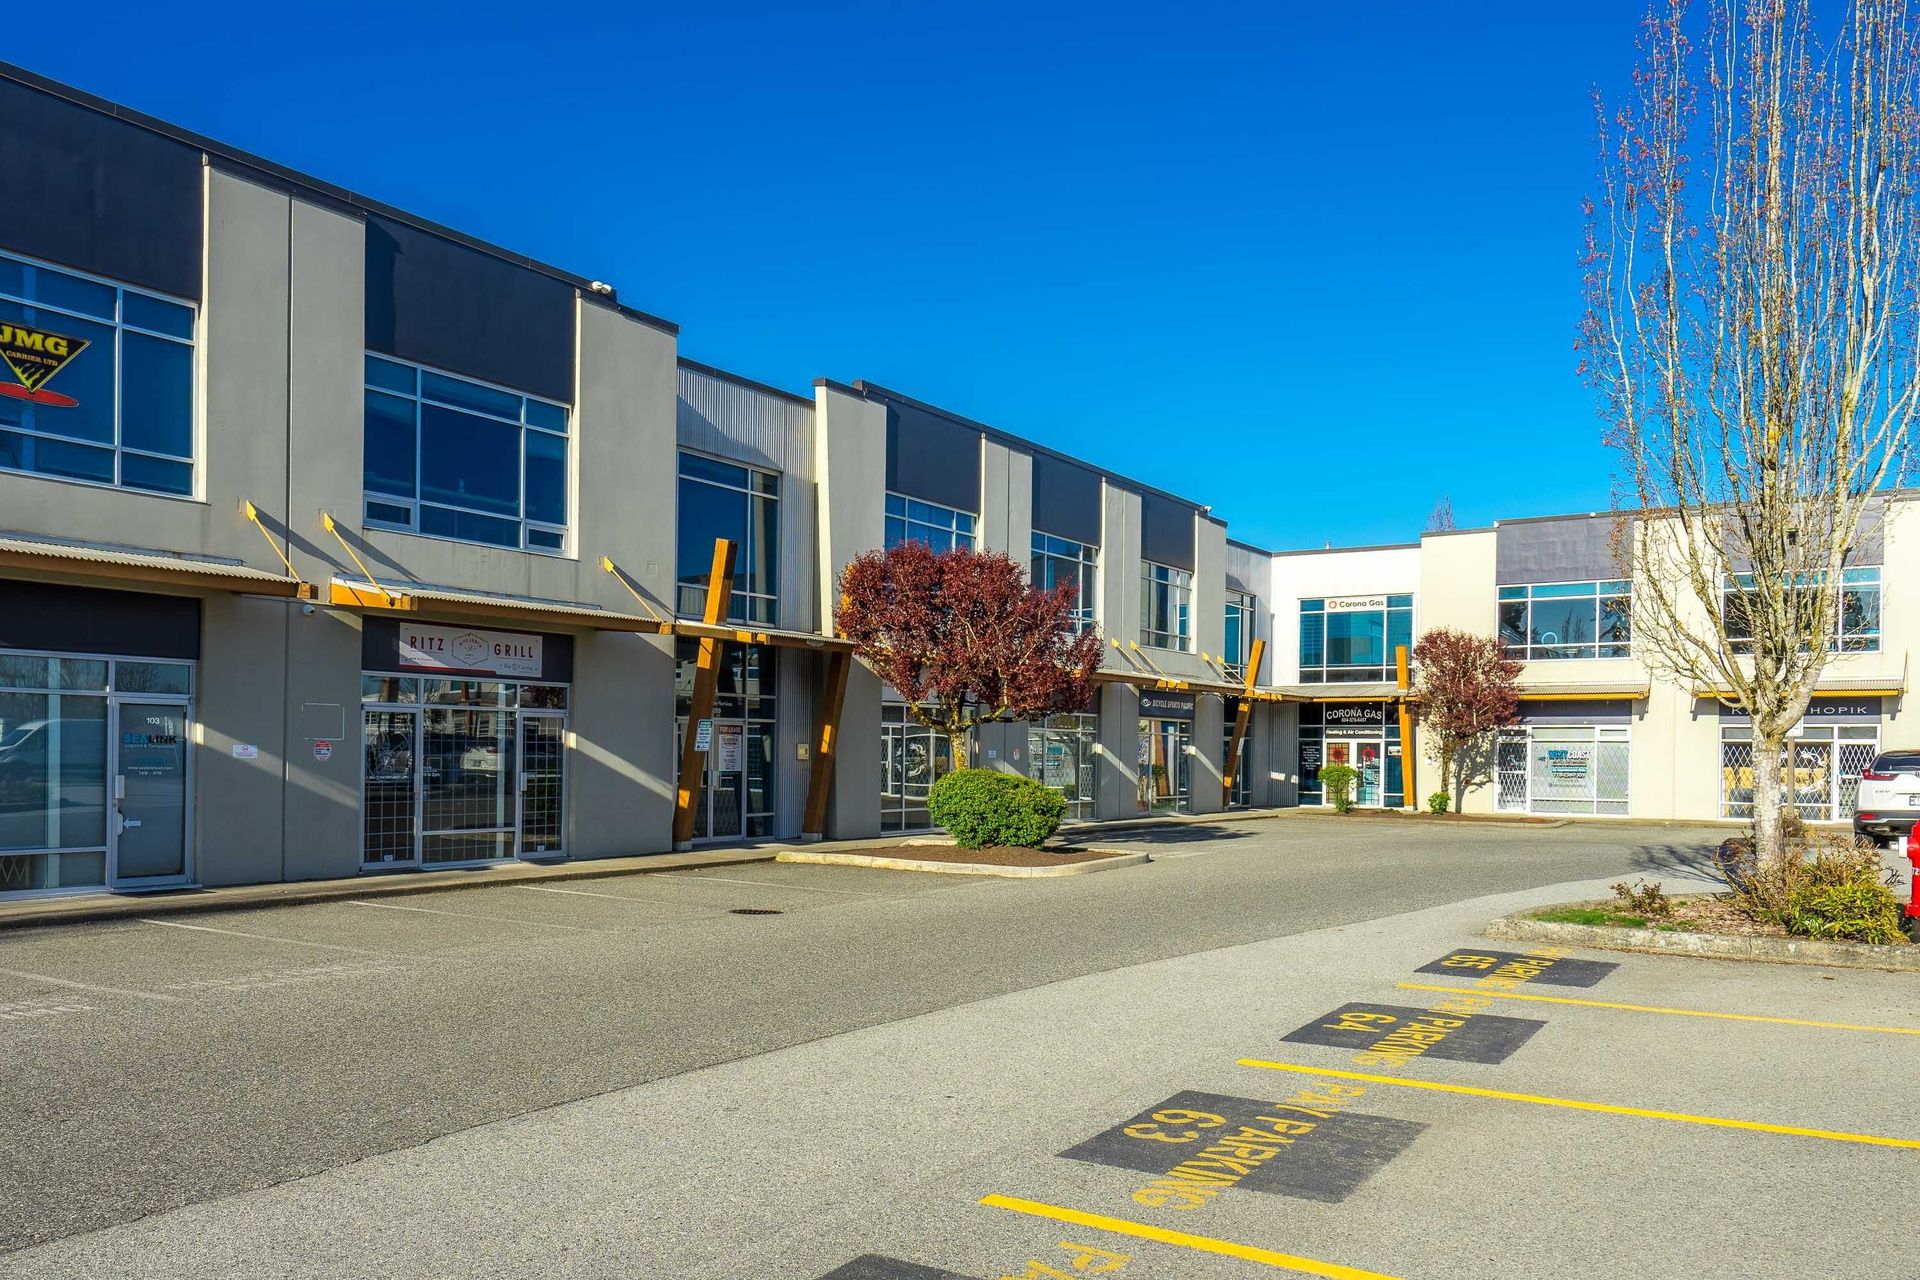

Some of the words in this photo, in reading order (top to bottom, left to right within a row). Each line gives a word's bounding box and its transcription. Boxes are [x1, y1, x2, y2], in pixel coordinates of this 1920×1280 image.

[0, 325, 69, 356] JMG
[6, 350, 42, 363] CARRIER
[43, 358, 59, 367] LTD
[1368, 599, 1384, 607] Gas
[410, 635, 445, 651] RITZ
[493, 643, 534, 659] GRILL
[1152, 699, 1167, 708] BICYCLE
[1167, 700, 1181, 709] SPORTS
[146, 717, 160, 725] 103
[1326, 708, 1363, 720] CORONA
[1363, 709, 1383, 720] GAS
[123, 732, 177, 744] SEALINK
[1440, 955, 1498, 969] 65
[1322, 1012, 1397, 1033] 64
[1351, 1016, 1467, 1069] PARKING
[1275, 1081, 1367, 1119] PAY
[1123, 1109, 1227, 1143] 63
[1131, 1115, 1317, 1211] PARKING
